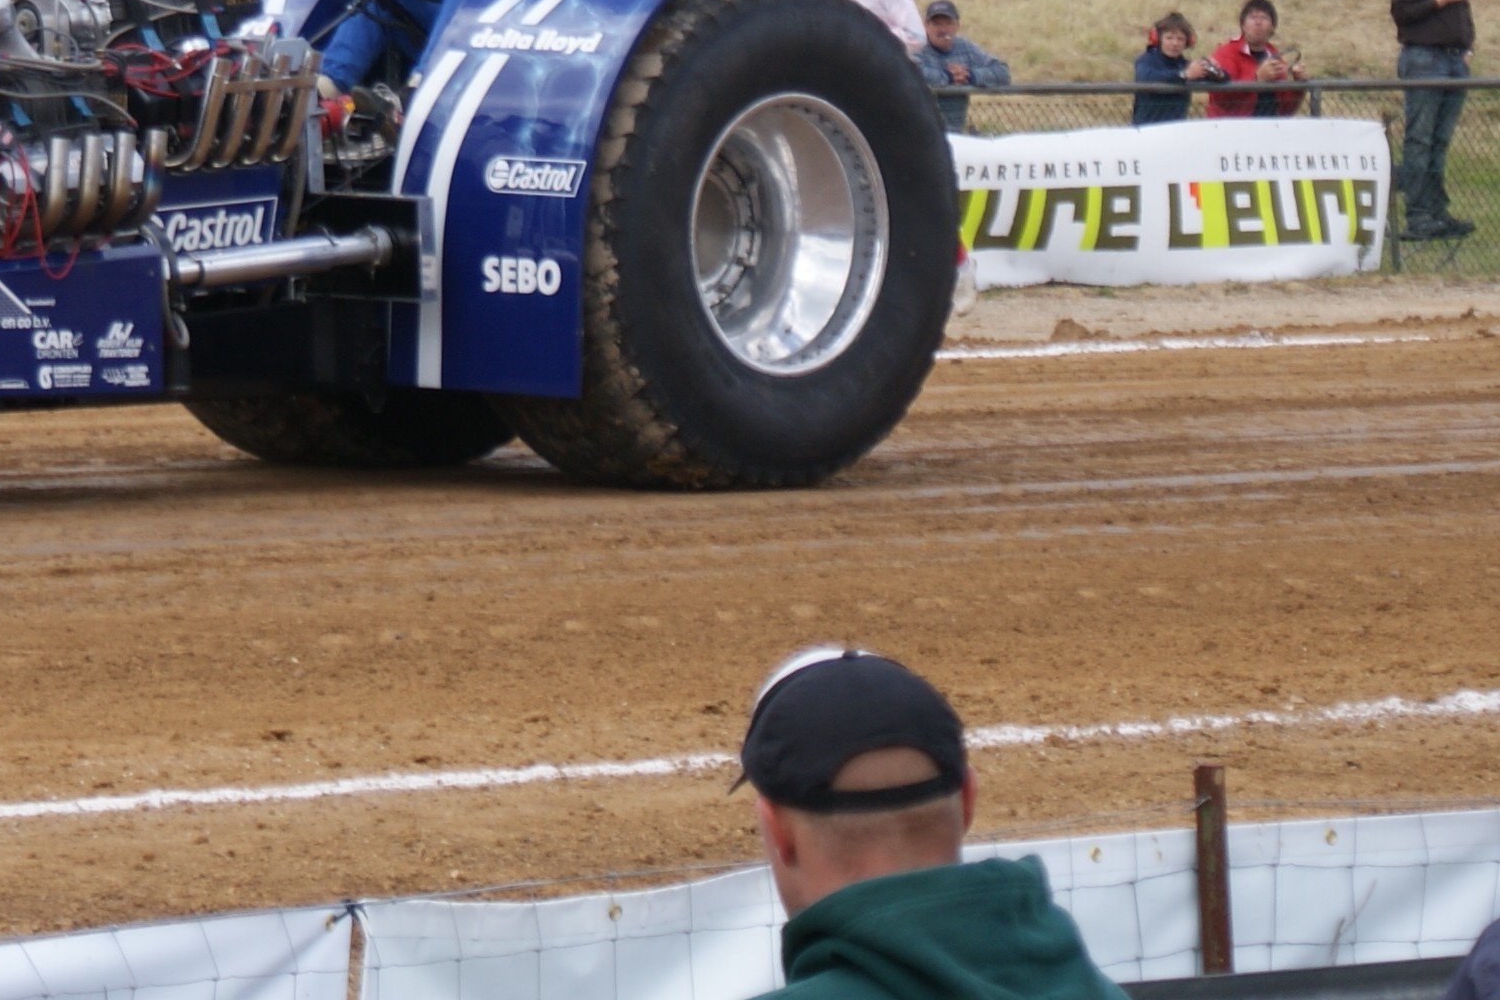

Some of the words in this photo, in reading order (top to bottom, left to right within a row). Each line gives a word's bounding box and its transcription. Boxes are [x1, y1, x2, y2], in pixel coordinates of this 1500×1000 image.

[470, 27, 534, 49] delta
[535, 29, 603, 55] lloyd
[507, 161, 577, 192] Castrol
[1118, 159, 1142, 176] DE
[1220, 151, 1349, 173] DÉPARTEMENT
[1361, 155, 1378, 172] DE
[166, 205, 265, 252] Castrol
[483, 255, 562, 296] SEBO
